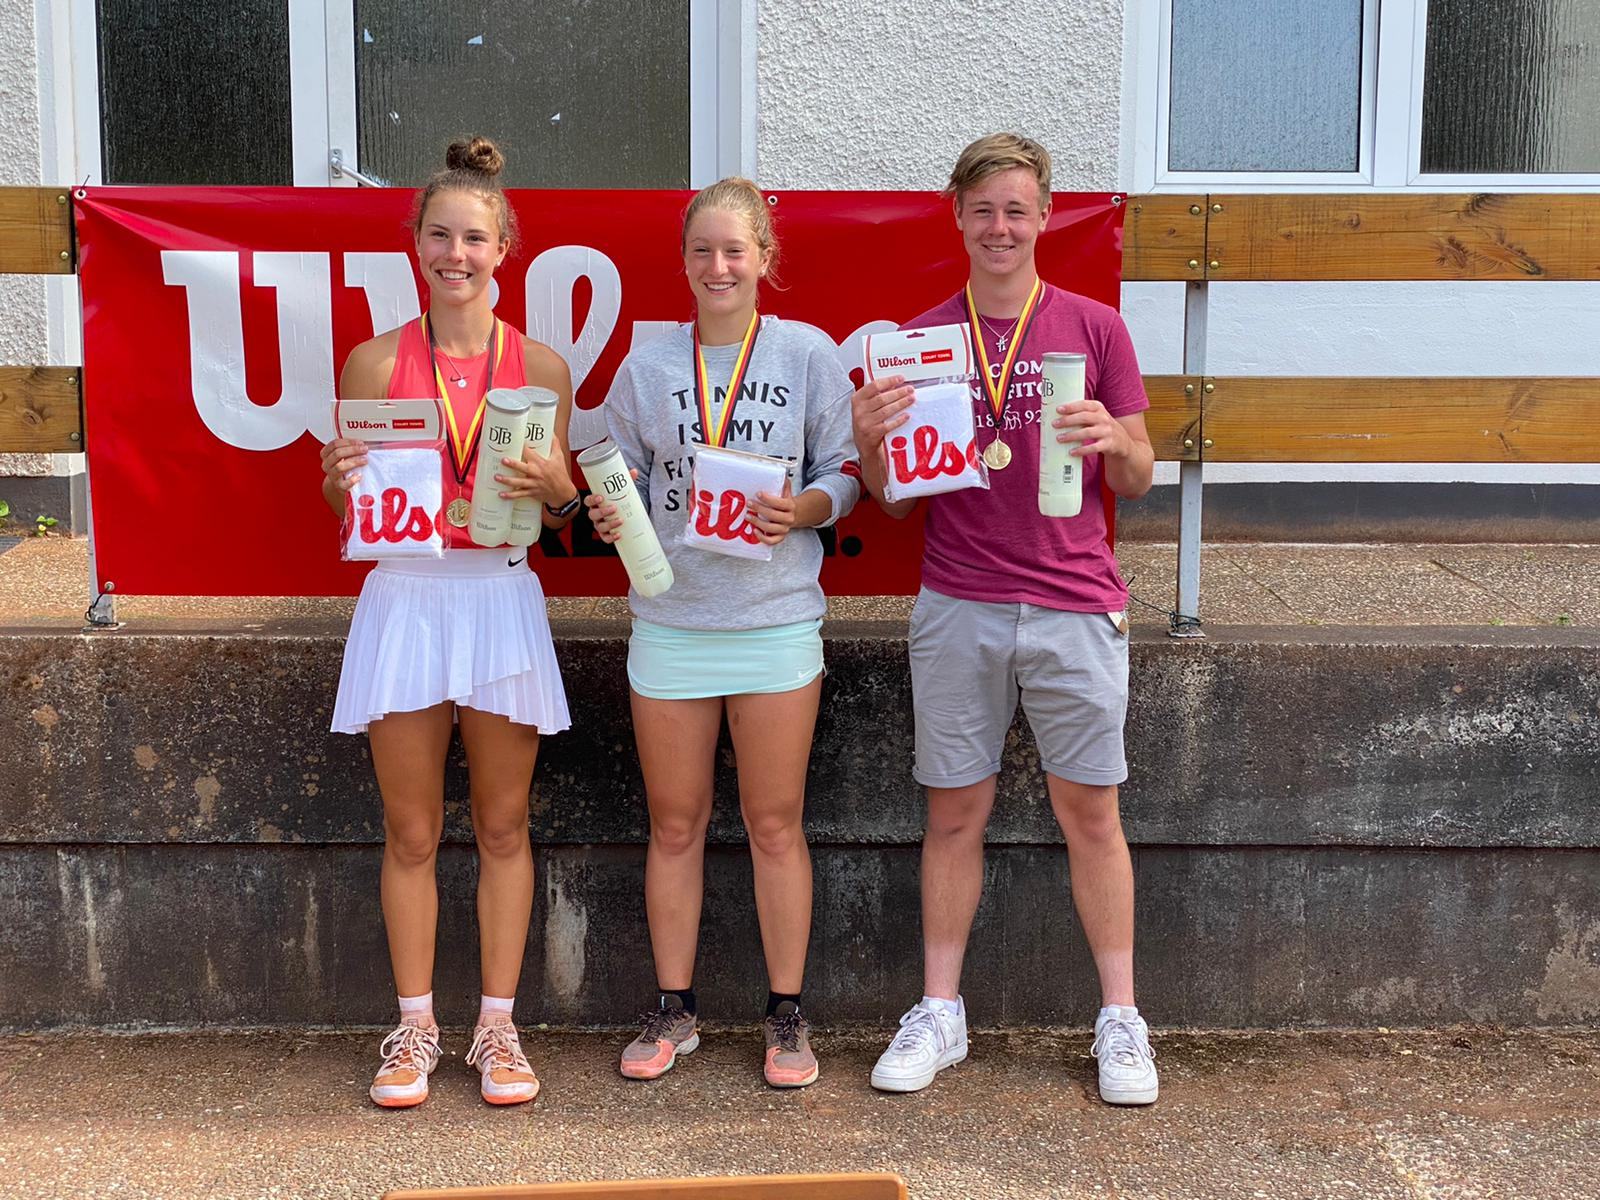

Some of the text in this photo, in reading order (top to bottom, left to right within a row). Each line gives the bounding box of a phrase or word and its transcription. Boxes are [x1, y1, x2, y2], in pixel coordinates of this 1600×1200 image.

[877, 357, 917, 369] Wilson
[346, 420, 387, 429] Wilson
[489, 425, 512, 446] DTB
[678, 419, 775, 446] IS MY
[890, 424, 980, 484] ils
[603, 472, 627, 494] DTB
[345, 486, 443, 545] ils
